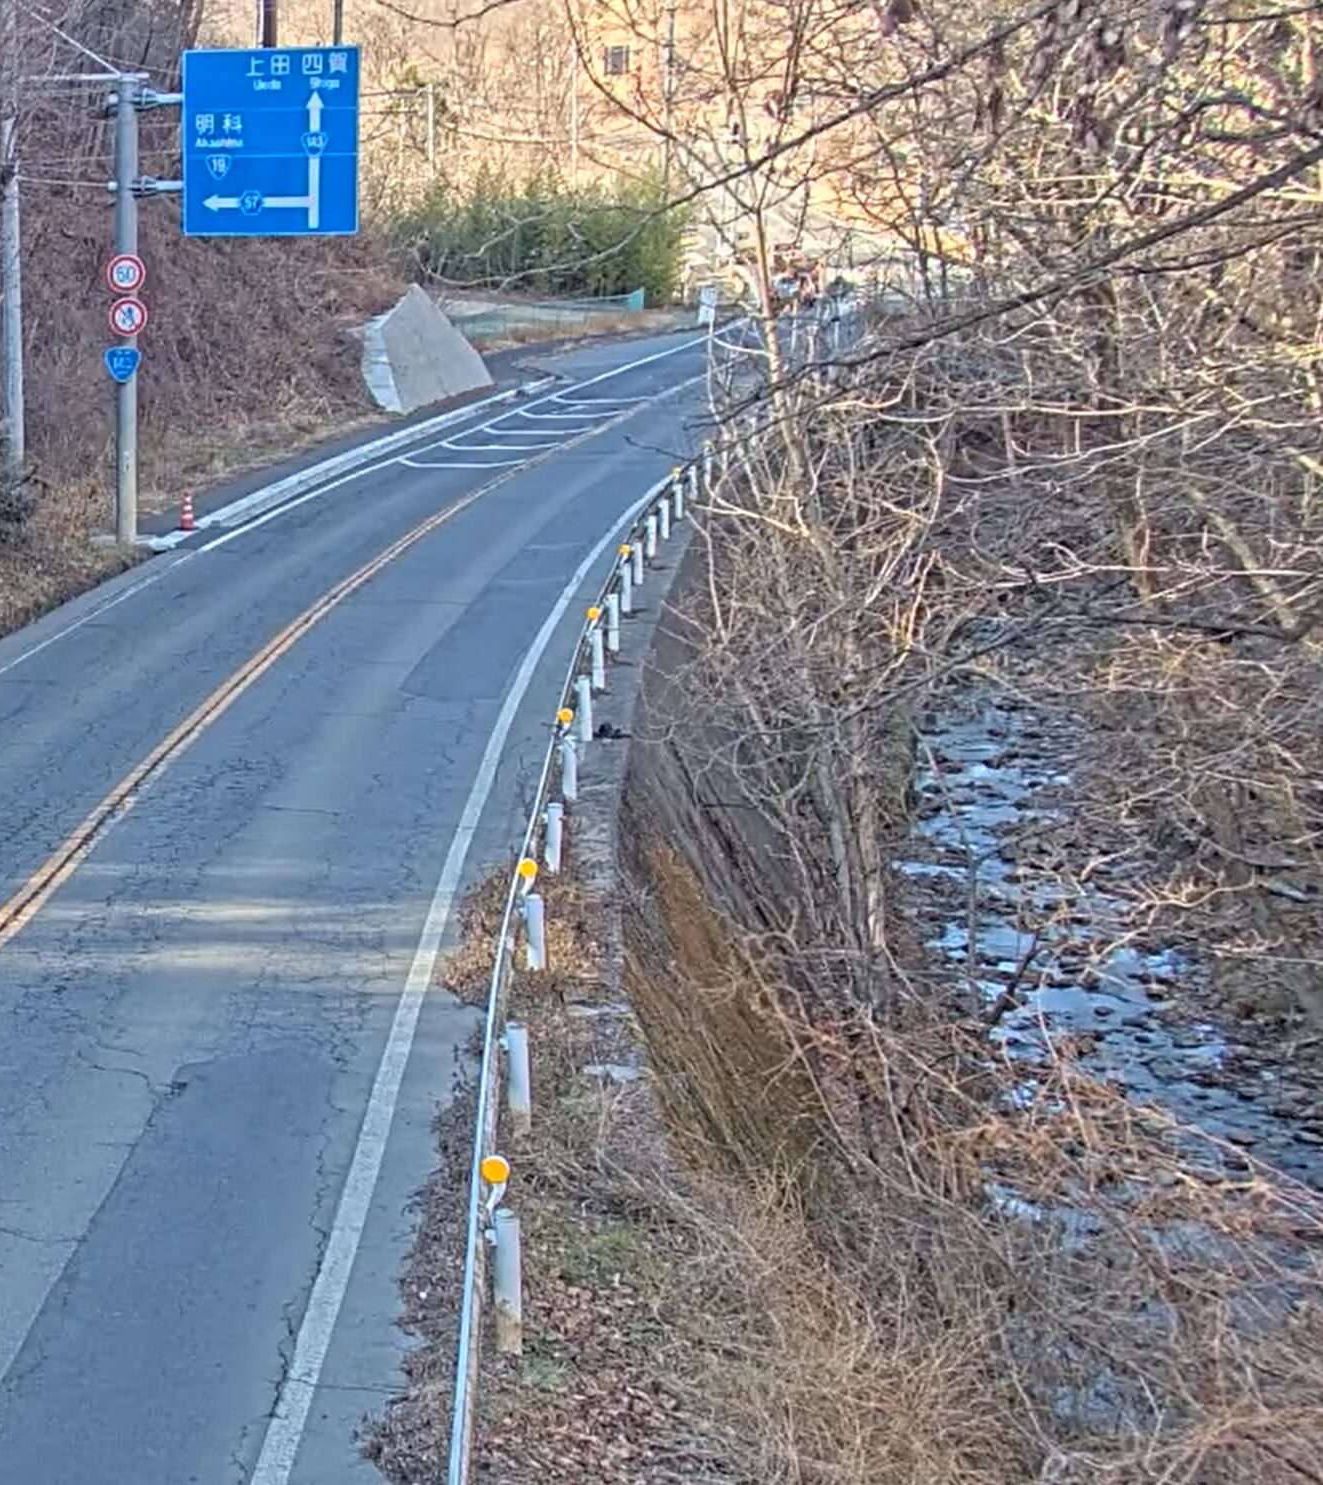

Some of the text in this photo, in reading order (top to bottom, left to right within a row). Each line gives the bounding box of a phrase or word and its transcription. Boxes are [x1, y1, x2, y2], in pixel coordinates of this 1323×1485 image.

[246, 52, 348, 77] 上田 四賀
[195, 113, 242, 136] 明科
[212, 158, 226, 172] 19
[244, 196, 259, 209] 57
